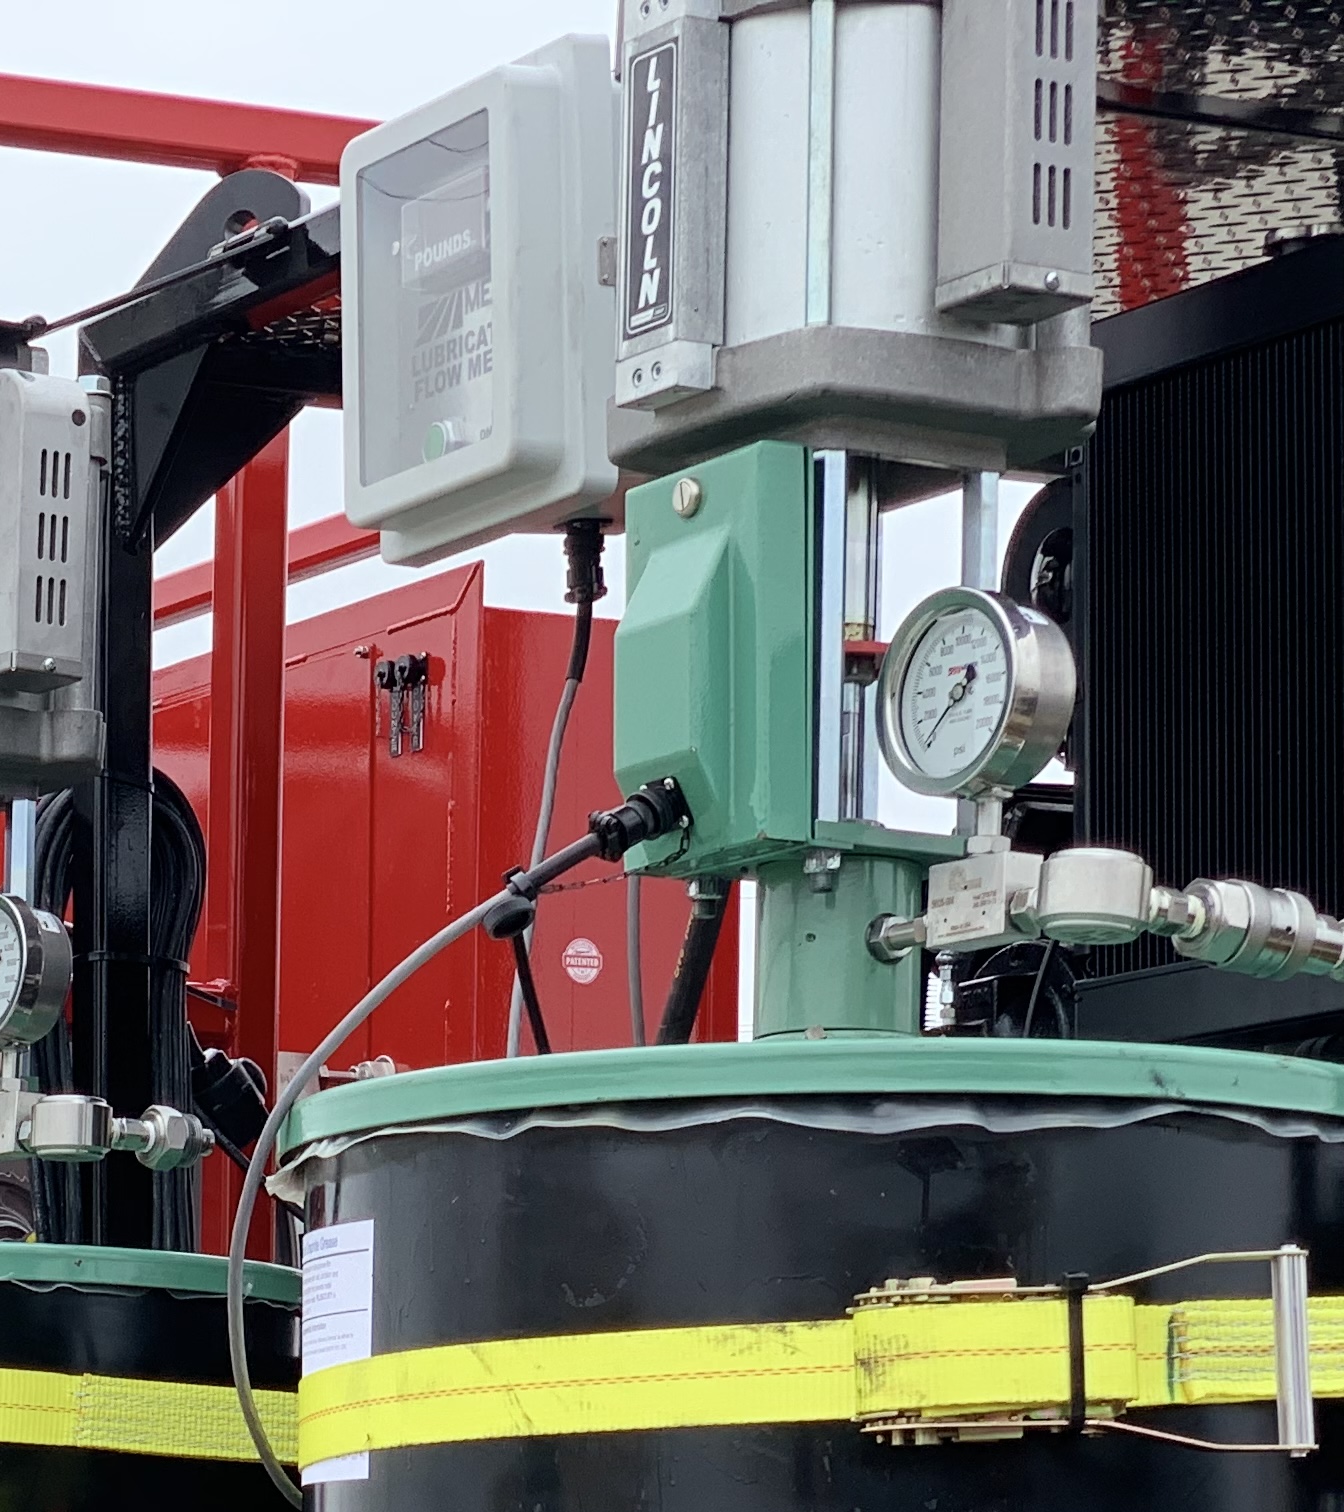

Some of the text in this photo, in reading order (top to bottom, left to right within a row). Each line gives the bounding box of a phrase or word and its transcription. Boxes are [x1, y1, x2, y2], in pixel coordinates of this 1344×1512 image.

[638, 57, 663, 309] LINCOLN
[414, 229, 471, 271] POUNDS
[464, 279, 492, 315] ME
[412, 322, 492, 377] LUBRICAT
[414, 349, 493, 401] FLOW ME
